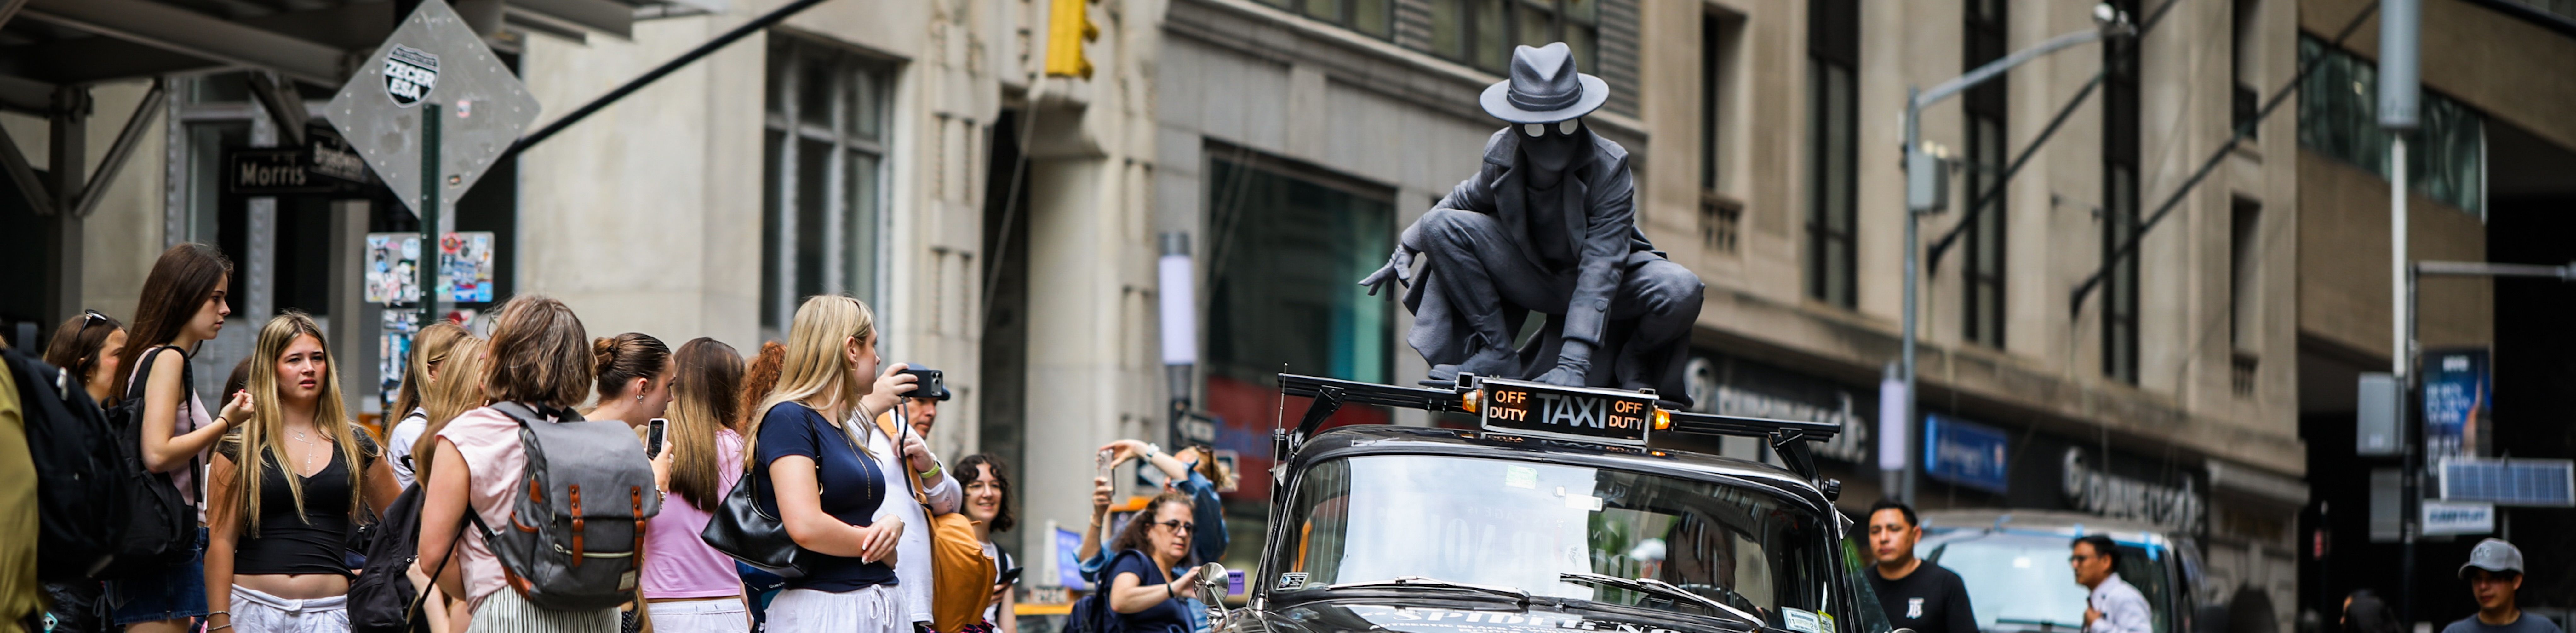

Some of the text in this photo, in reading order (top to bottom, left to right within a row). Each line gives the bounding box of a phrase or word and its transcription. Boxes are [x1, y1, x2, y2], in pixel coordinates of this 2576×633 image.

[390, 78, 421, 101] ESA
[241, 160, 306, 185] Morris
[1495, 390, 1527, 404] OFF
[1489, 407, 1527, 422] DUTY
[1536, 393, 1606, 429] TAXI
[1615, 400, 1643, 414] OFF
[1609, 415, 1643, 430] DUTY
